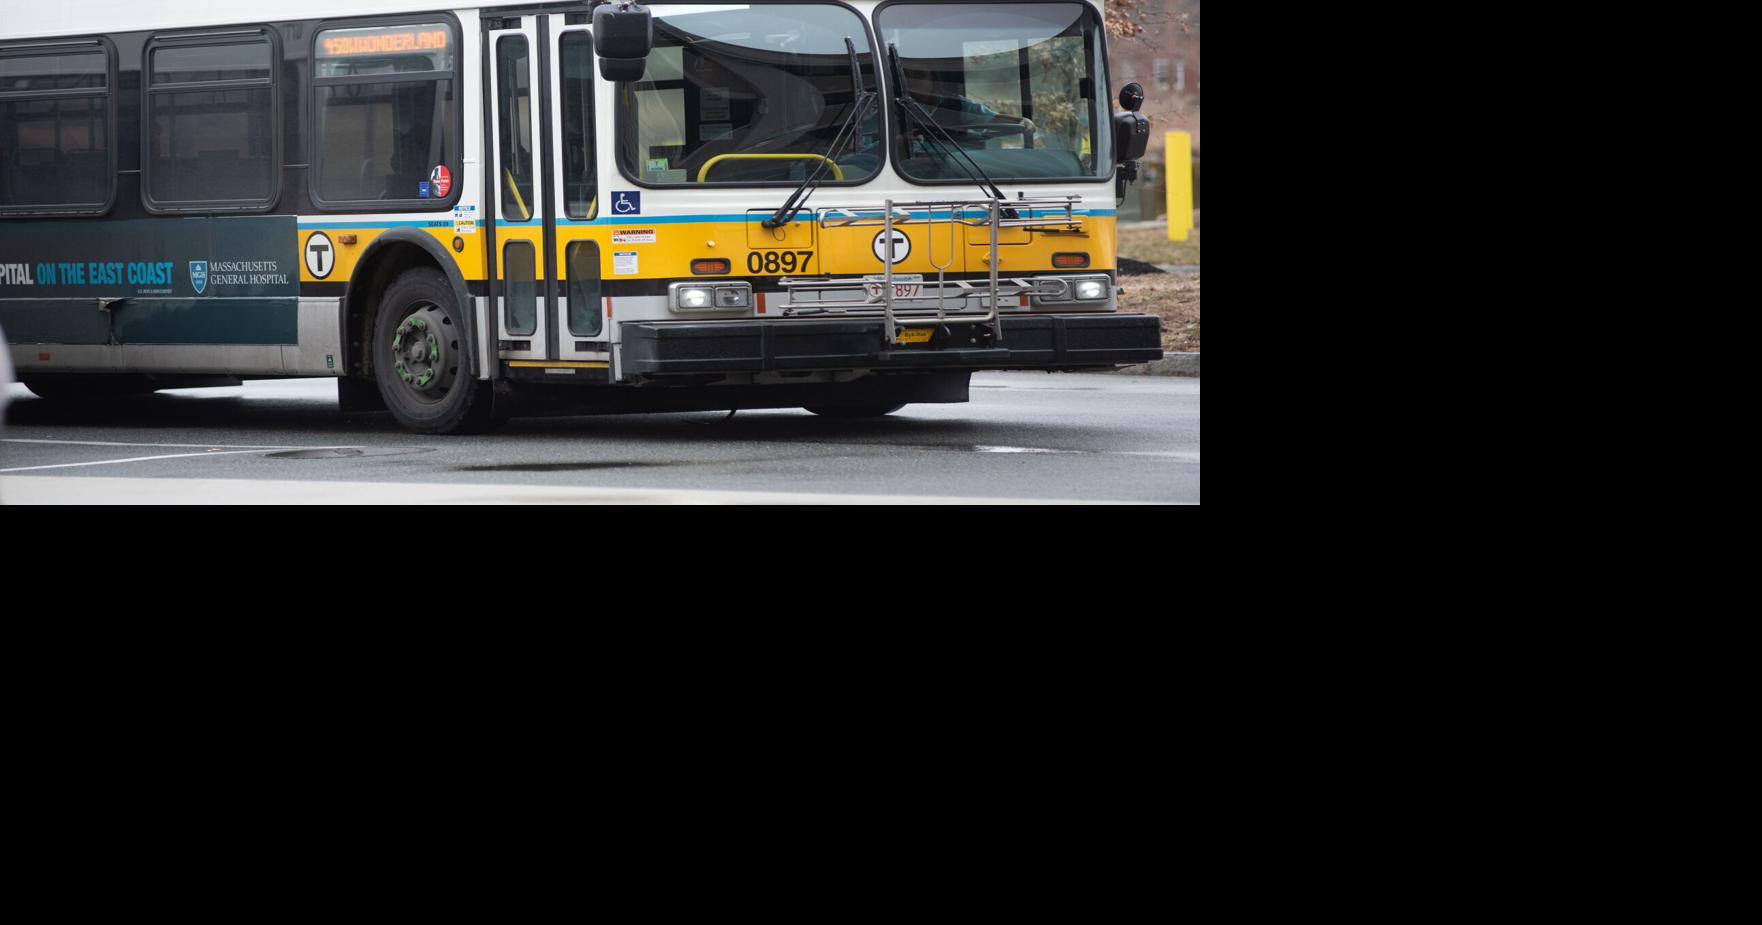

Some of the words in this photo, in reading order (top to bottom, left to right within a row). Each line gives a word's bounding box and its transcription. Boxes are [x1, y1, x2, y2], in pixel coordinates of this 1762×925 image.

[210, 260, 278, 272] MASSACHUSETTS
[309, 244, 329, 272] T
[747, 250, 814, 274] 0897
[0, 263, 34, 285] PITAL
[36, 262, 56, 285] ON
[58, 262, 86, 285] THE
[88, 261, 124, 285] EAST
[127, 261, 174, 285] COAST
[210, 274, 249, 285] GENERAL
[249, 273, 289, 285] HOSPITAL
